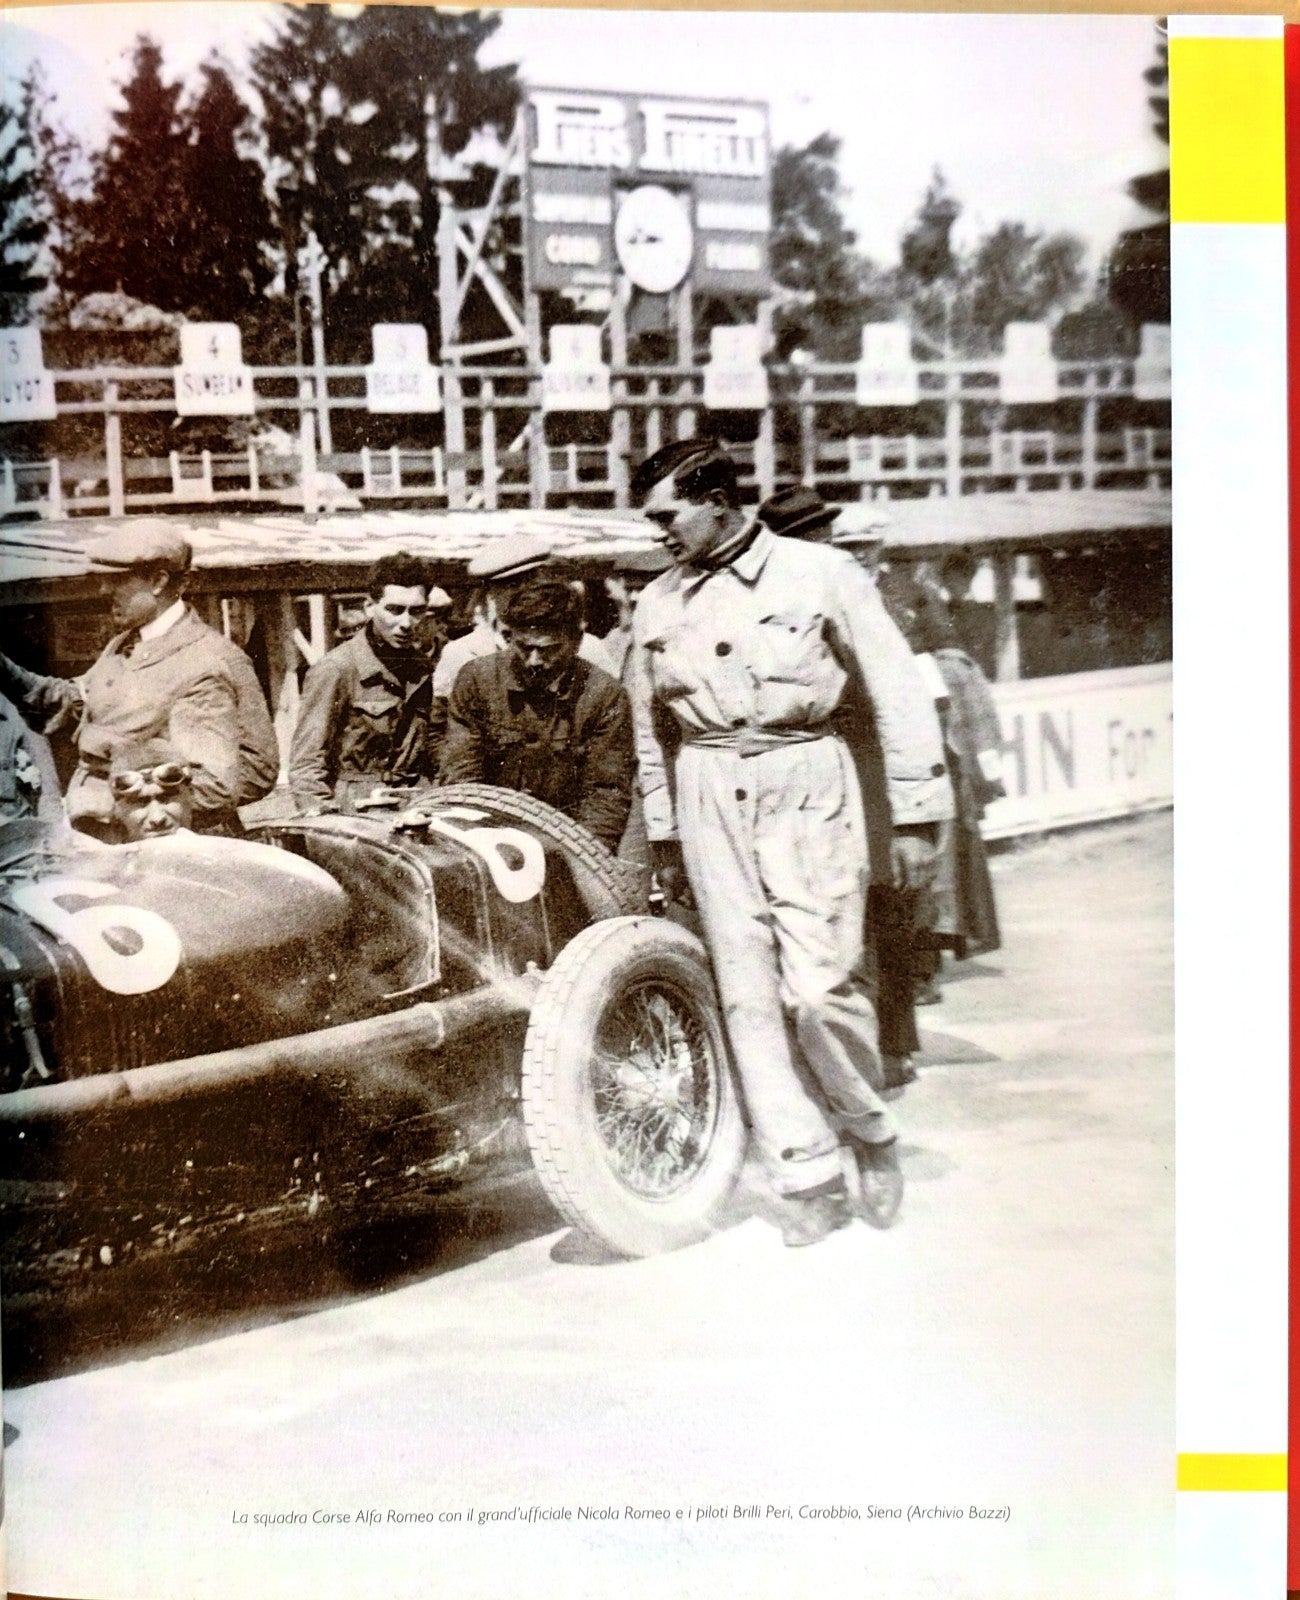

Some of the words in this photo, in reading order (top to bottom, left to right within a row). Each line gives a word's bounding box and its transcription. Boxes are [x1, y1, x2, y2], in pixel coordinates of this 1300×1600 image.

[637, 97, 767, 174] PIRELLI
[8, 339, 21, 365] 3
[209, 334, 220, 359] 4
[427, 807, 546, 904] 6
[9, 878, 182, 995] 6
[231, 1509, 249, 1524] La
[253, 1510, 308, 1528] squadra
[311, 1509, 351, 1524] Corse
[354, 1508, 383, 1527] Alfa
[386, 1509, 434, 1524] Romeo
[438, 1511, 462, 1523] con
[466, 1507, 474, 1522] il
[477, 1505, 573, 1526] grand'ufficiale
[577, 1506, 620, 1521] Nicola
[624, 1505, 671, 1520] Romeo
[675, 1508, 684, 1520] e
[688, 1505, 692, 1519] i
[695, 1504, 729, 1523] piloti
[732, 1504, 761, 1519] Brilli
[765, 1504, 793, 1523] Peri,
[798, 1504, 861, 1523] Carobbio,
[866, 1504, 903, 1519] Siena
[906, 1503, 964, 1524] (Archivio
[968, 1504, 1011, 1524] Bazzi)
